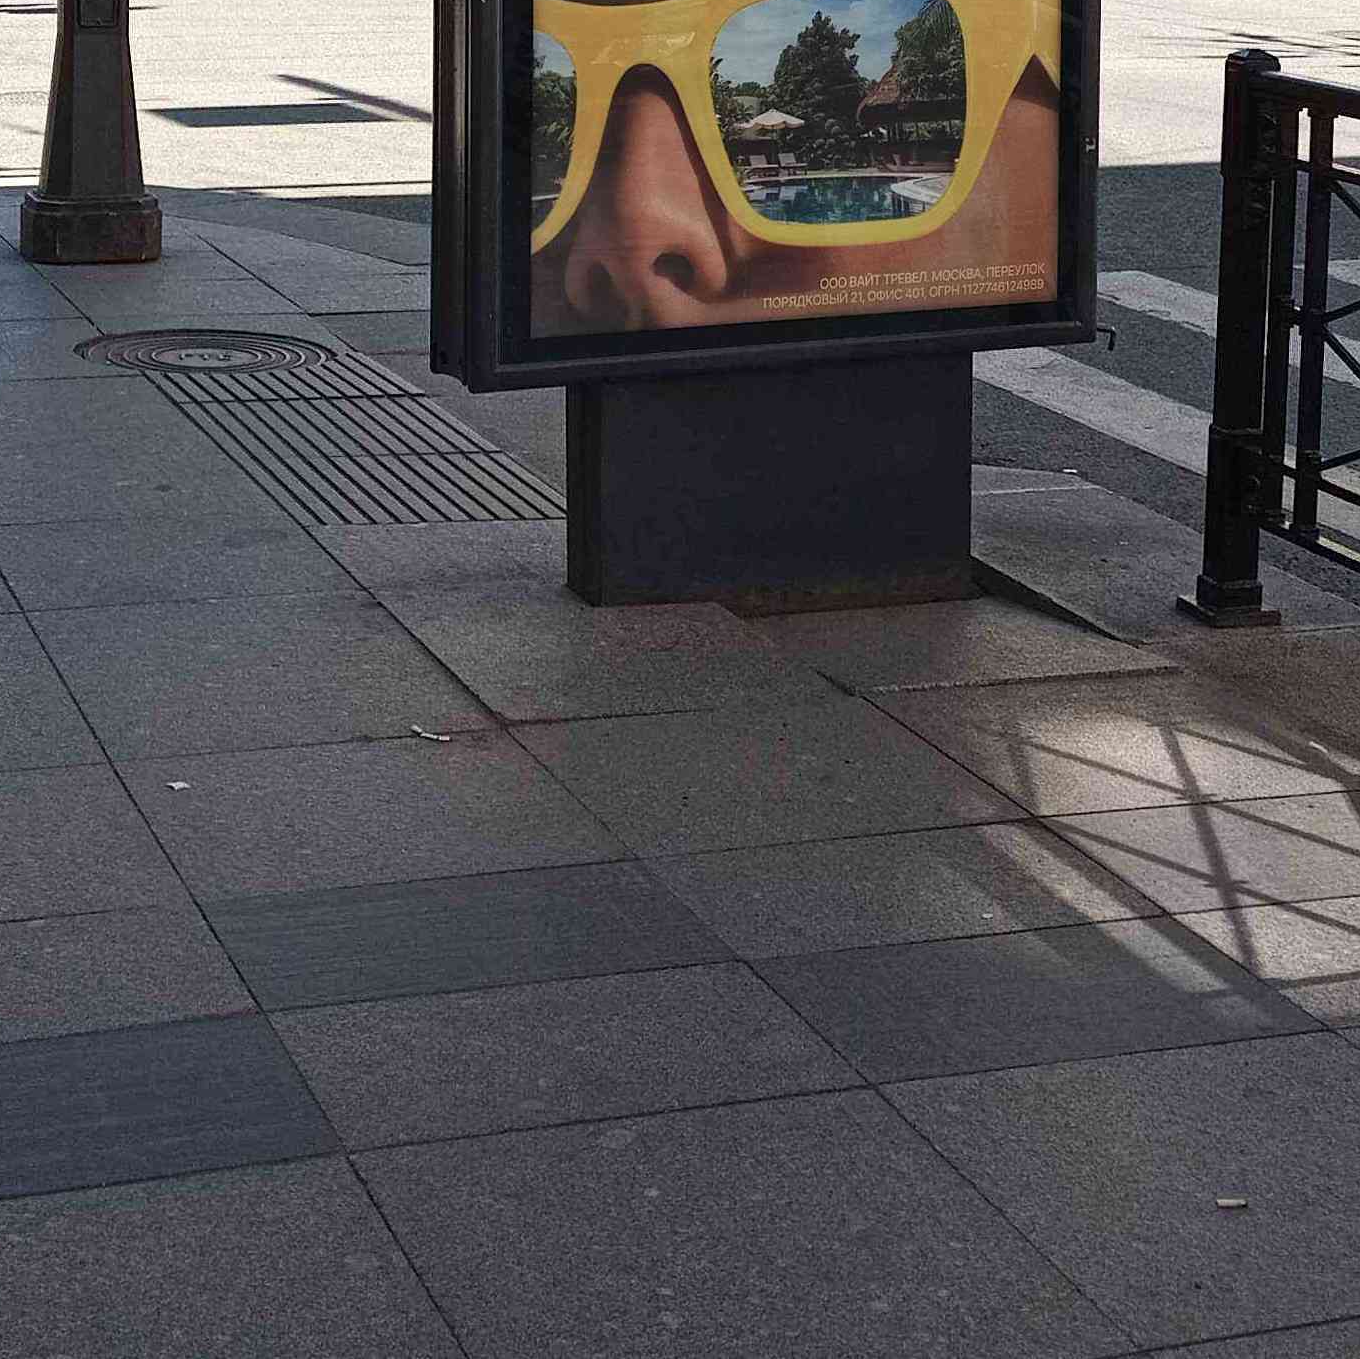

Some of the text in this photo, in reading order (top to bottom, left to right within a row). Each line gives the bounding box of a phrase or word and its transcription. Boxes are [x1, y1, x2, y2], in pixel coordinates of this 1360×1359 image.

[819, 276, 847, 290] ООО
[849, 272, 881, 288] ВАЙТ
[986, 263, 1046, 278] ПЕРЕУЛОК
[762, 291, 848, 309] ПОРЯДКОВЫЙ
[867, 288, 904, 302] ОФИС
[929, 283, 960, 298] ОГРН
